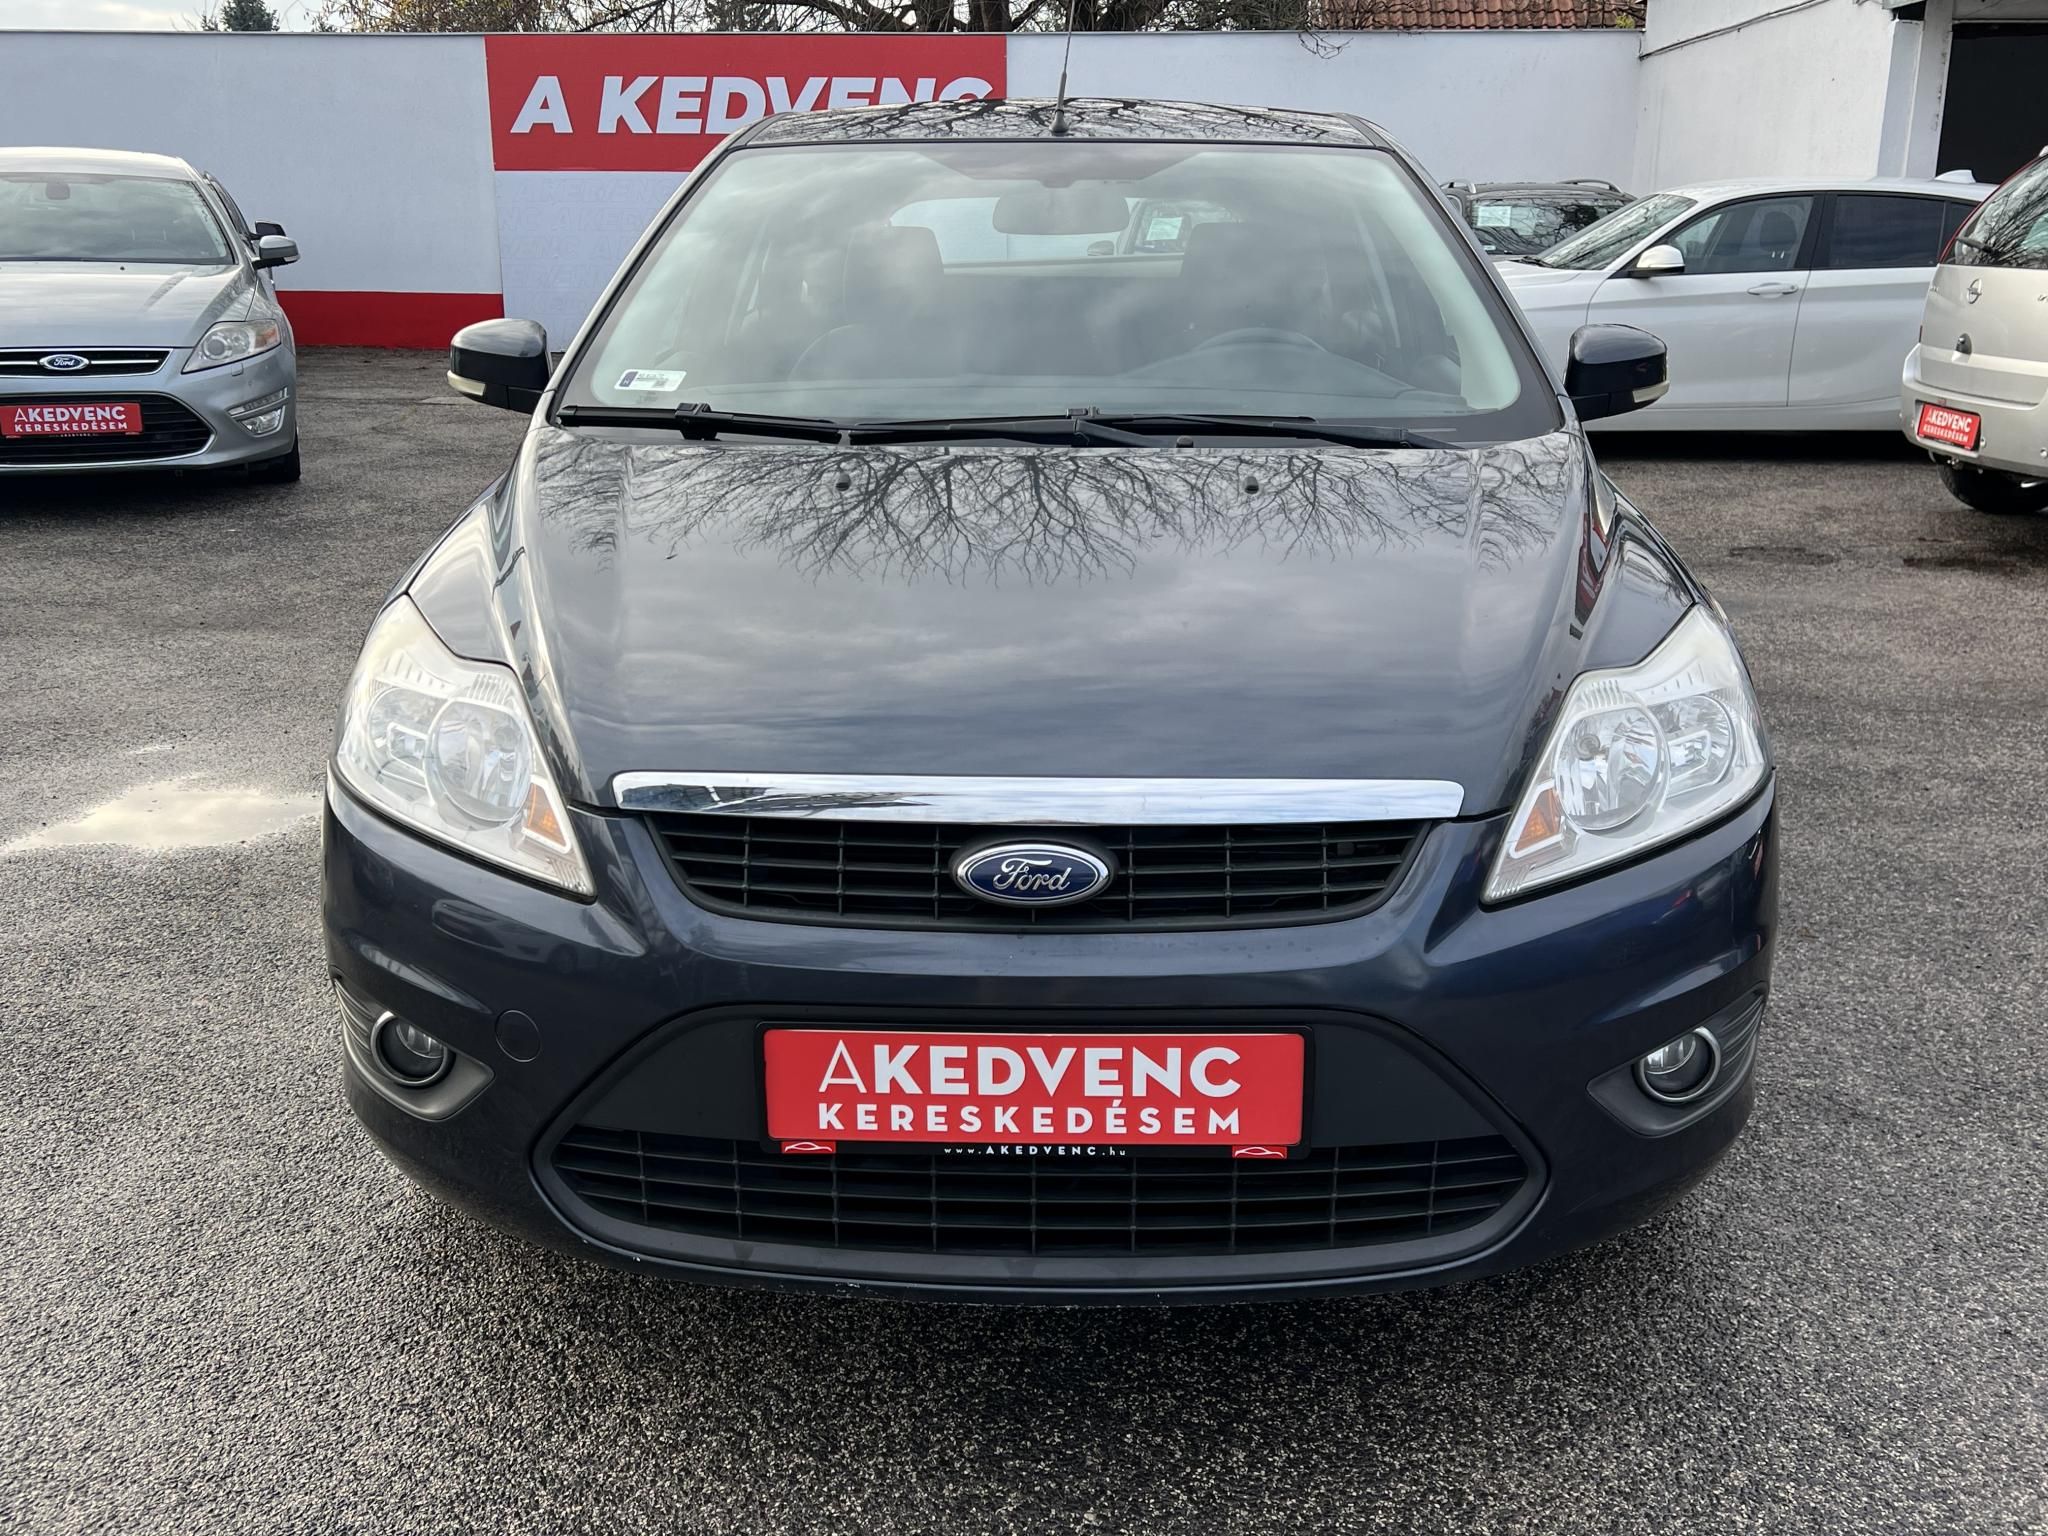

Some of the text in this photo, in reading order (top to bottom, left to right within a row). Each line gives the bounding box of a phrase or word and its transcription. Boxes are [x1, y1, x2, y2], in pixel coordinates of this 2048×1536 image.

[510, 75, 574, 134] A
[53, 357, 76, 366] Ford
[14, 421, 128, 433] KERESKEDÉSEM
[992, 857, 1073, 891] Ford
[818, 1039, 1242, 1098] AKEDVENC
[818, 1099, 1240, 1135] KERESKEDÉSEM
[944, 1145, 1126, 1156] www.AKEDVENC.hu
